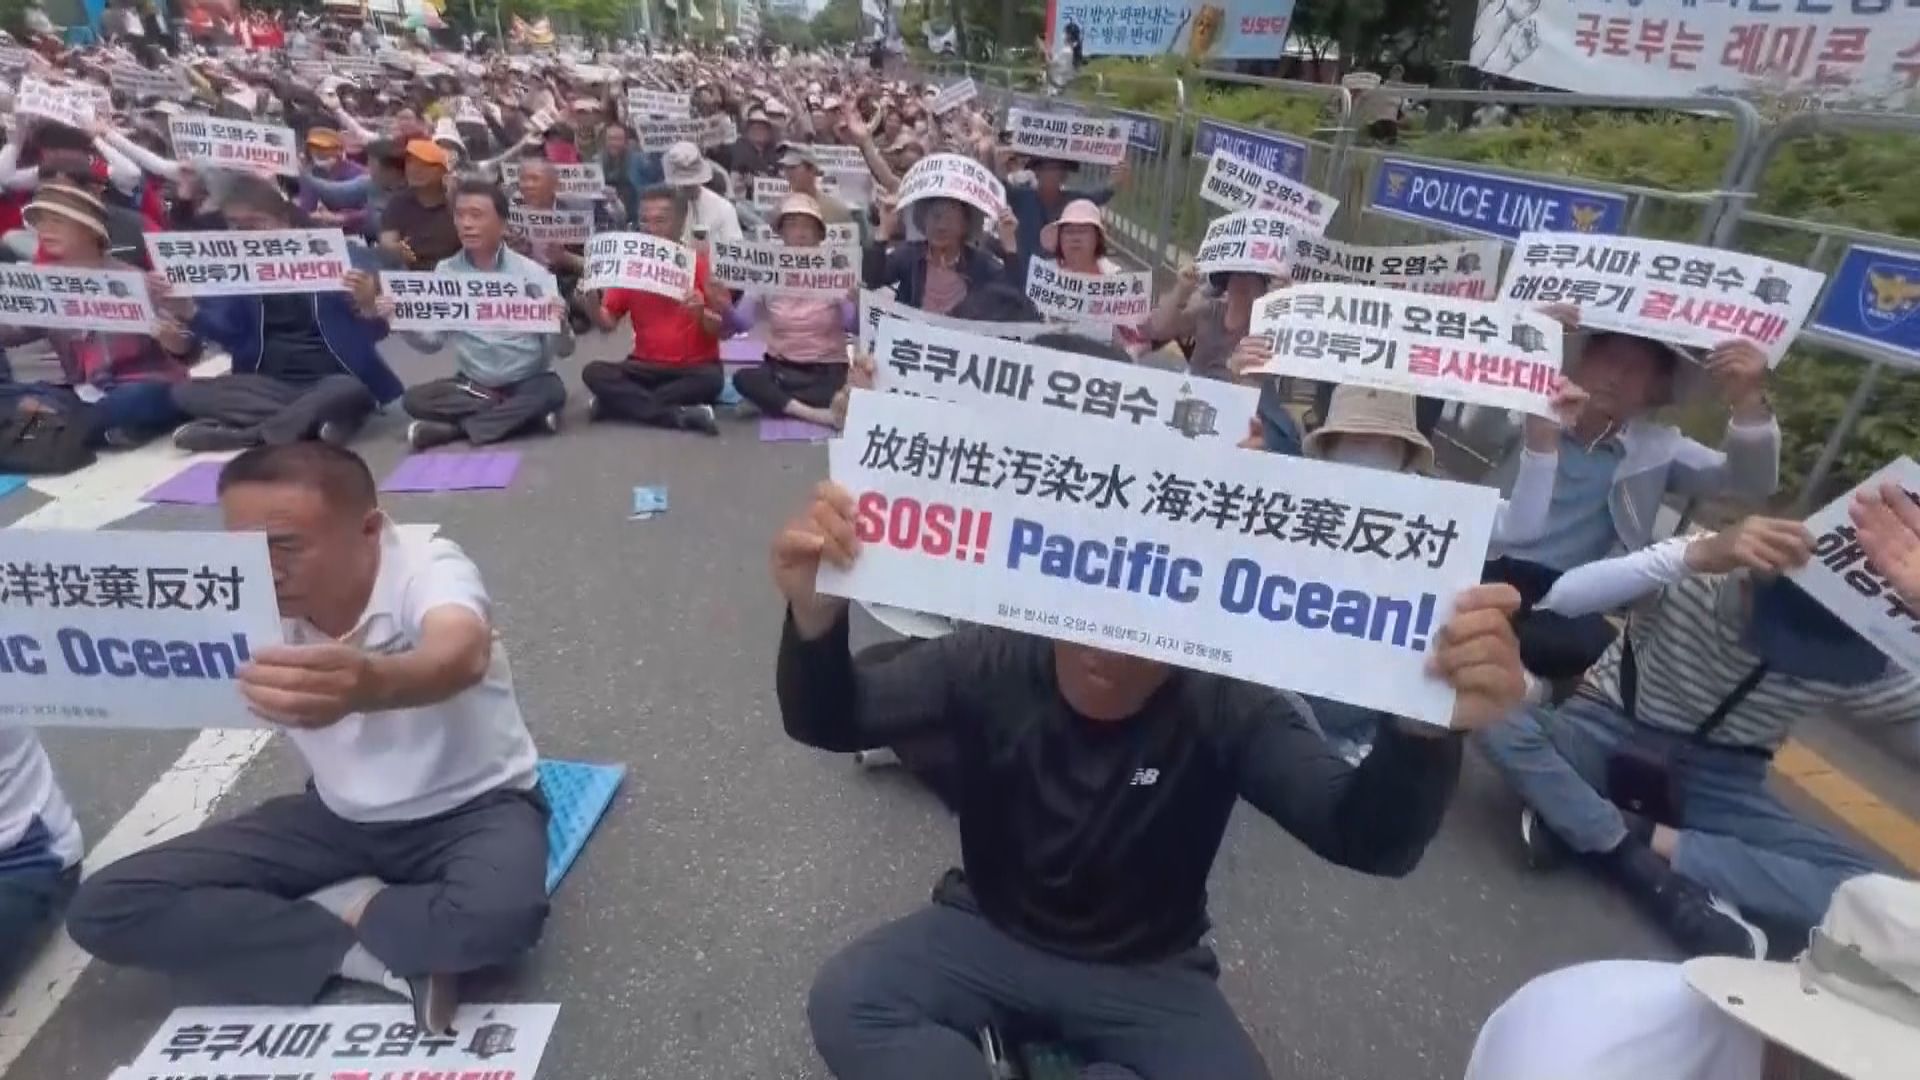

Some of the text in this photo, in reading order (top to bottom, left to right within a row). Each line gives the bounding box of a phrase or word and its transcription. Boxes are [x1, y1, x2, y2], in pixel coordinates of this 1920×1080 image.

[1575, 13, 1704, 70] 국토부는
[1720, 24, 1871, 85] 레미콘
[1021, 116, 1068, 135] 후쿠시마
[1215, 131, 1280, 173] POLICE LINE
[1207, 176, 1257, 208] 해양투기
[1215, 158, 1304, 207] 후쿠시마 오염수
[1409, 176, 1560, 231] POLICE LINE
[156, 239, 302, 259] 후쿠시마 오염수
[623, 240, 670, 262] 오염수
[715, 242, 826, 270] 후쿠시마 오염수
[1297, 240, 1449, 276] 후쿠시마 오염수
[1524, 243, 1745, 293] 후쿠시마 오염수
[46, 275, 103, 294] 오염수
[165, 261, 343, 284] 해양투기 결사반대!
[389, 279, 518, 298] 후쿠시마 오염수
[715, 264, 779, 284] 해양투기
[1032, 264, 1129, 297] 후쿠시마 오염수
[394, 302, 469, 320] 해양투기
[1029, 283, 1083, 314] 해양투기
[1510, 274, 1789, 346] 해양투기 결사반대!
[1262, 295, 1499, 342] 후쿠시마 오염수
[1262, 327, 1398, 370] 해양투기
[889, 338, 1158, 425] 후쿠시마 오염수
[859, 423, 1459, 569] 放射性汚染水 海洋投棄反対
[854, 491, 1437, 652] SOS!! Pacific Ocean!
[57, 627, 250, 679] Ocean!
[160, 1022, 329, 1063] 후쿠시마
